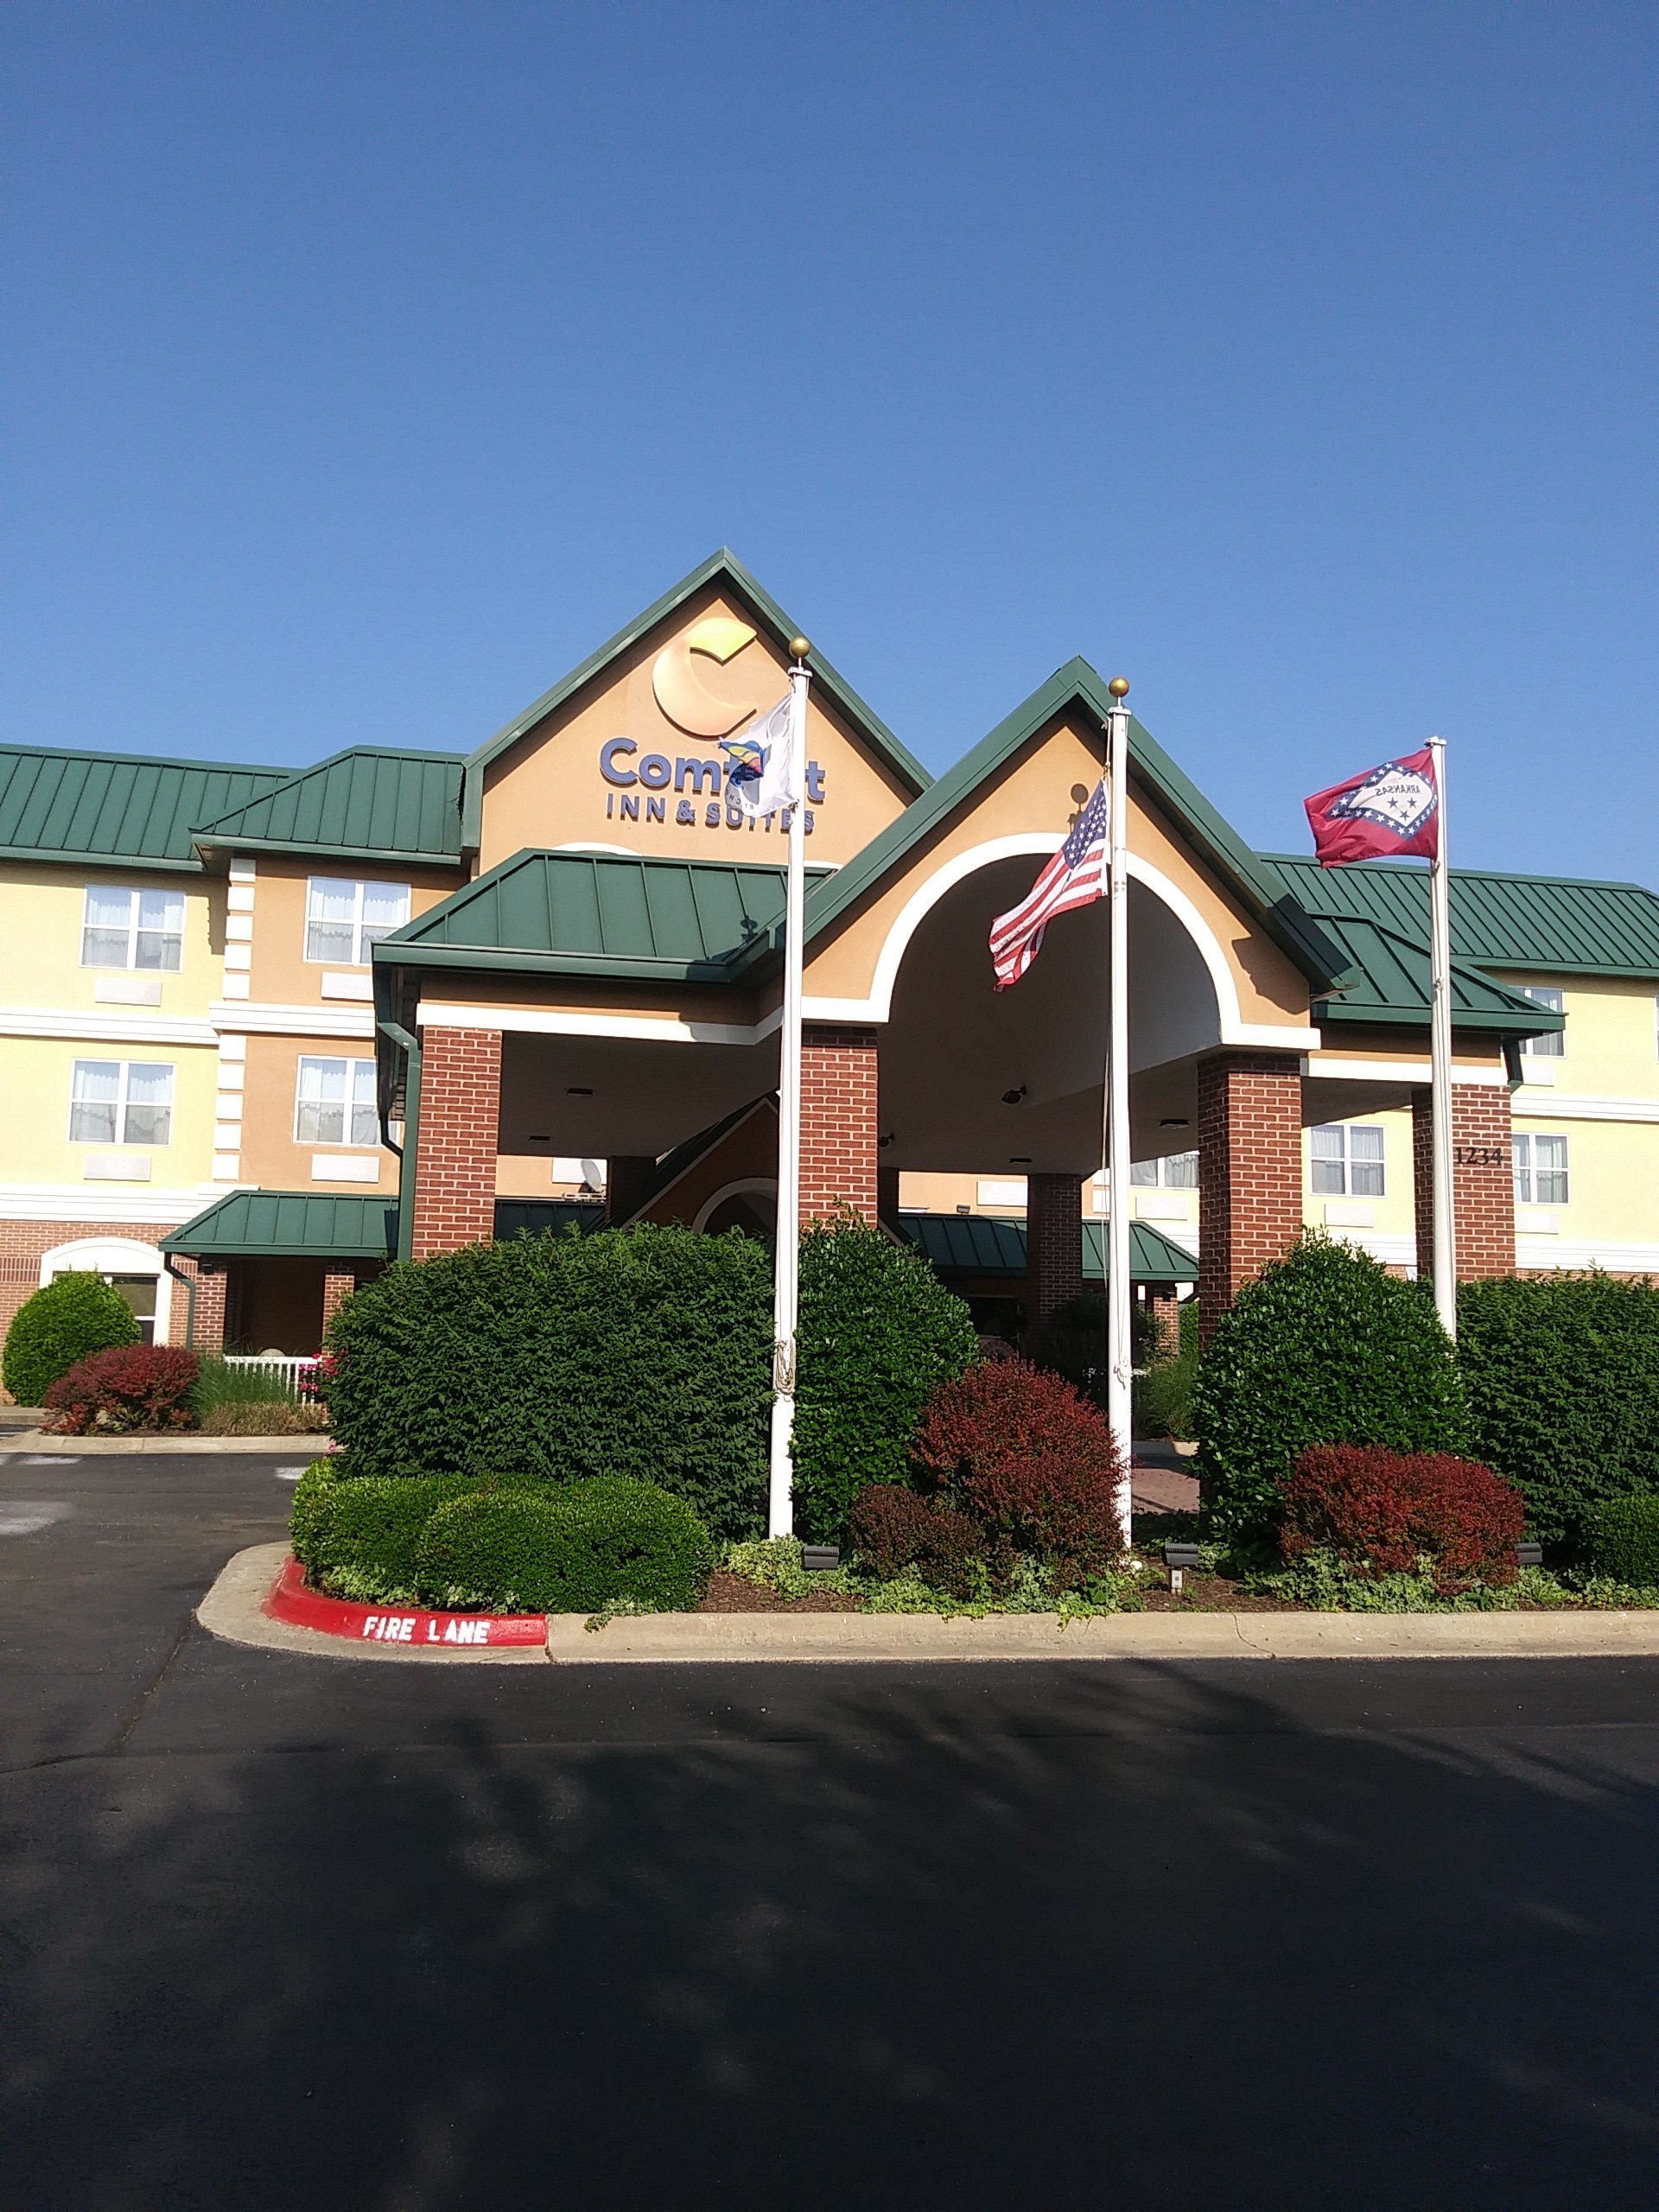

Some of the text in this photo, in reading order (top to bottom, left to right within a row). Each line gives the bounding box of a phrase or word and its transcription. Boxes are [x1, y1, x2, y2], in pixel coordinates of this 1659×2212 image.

[600, 737, 826, 802] Comt
[607, 793, 666, 819] INN
[676, 799, 696, 822] &
[1455, 1147, 1503, 1166] 1234
[363, 1616, 491, 1644] FIRE LANE
